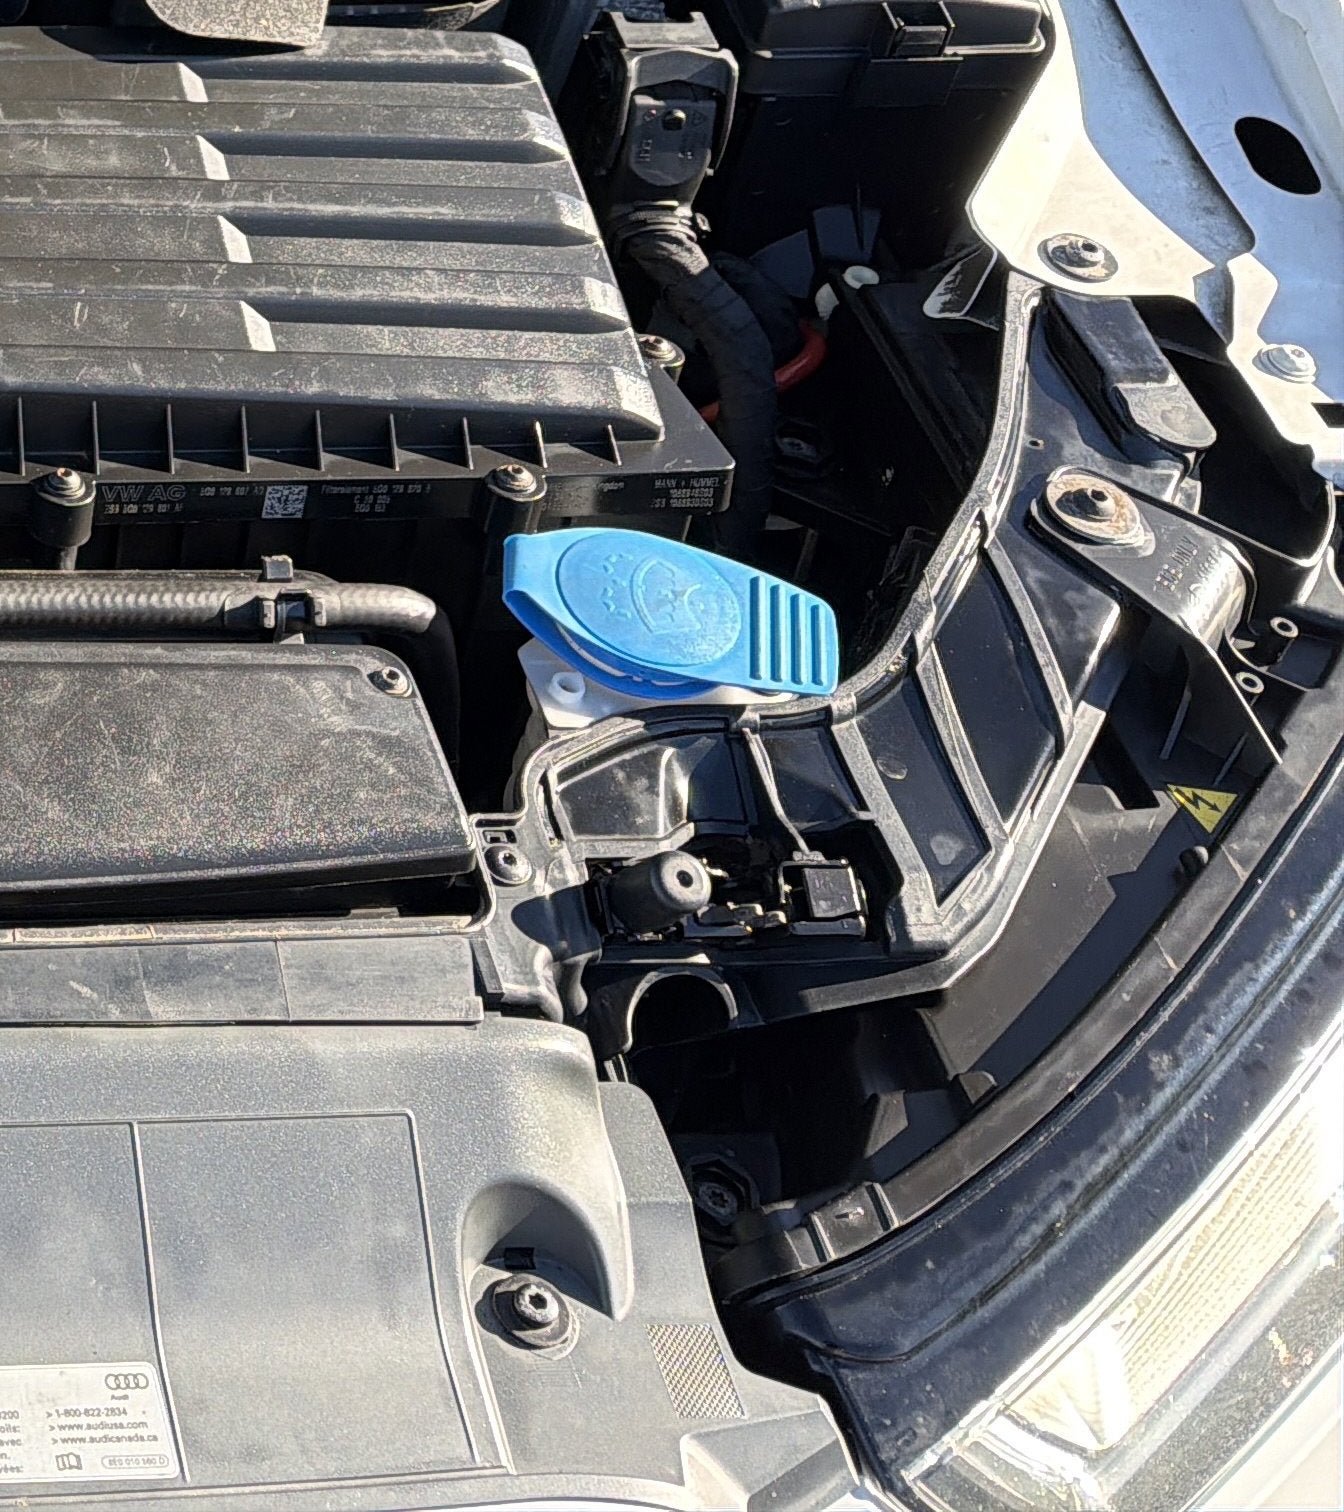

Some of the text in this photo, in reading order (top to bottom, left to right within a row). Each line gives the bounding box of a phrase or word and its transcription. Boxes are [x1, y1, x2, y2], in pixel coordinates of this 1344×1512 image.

[103, 486, 144, 501] VW
[148, 486, 186, 501] AG
[54, 1407, 128, 1418] 1-800-822-2834
[57, 1421, 149, 1431] www.audiusa.com
[59, 1433, 159, 1444] www.audicanada.ca
